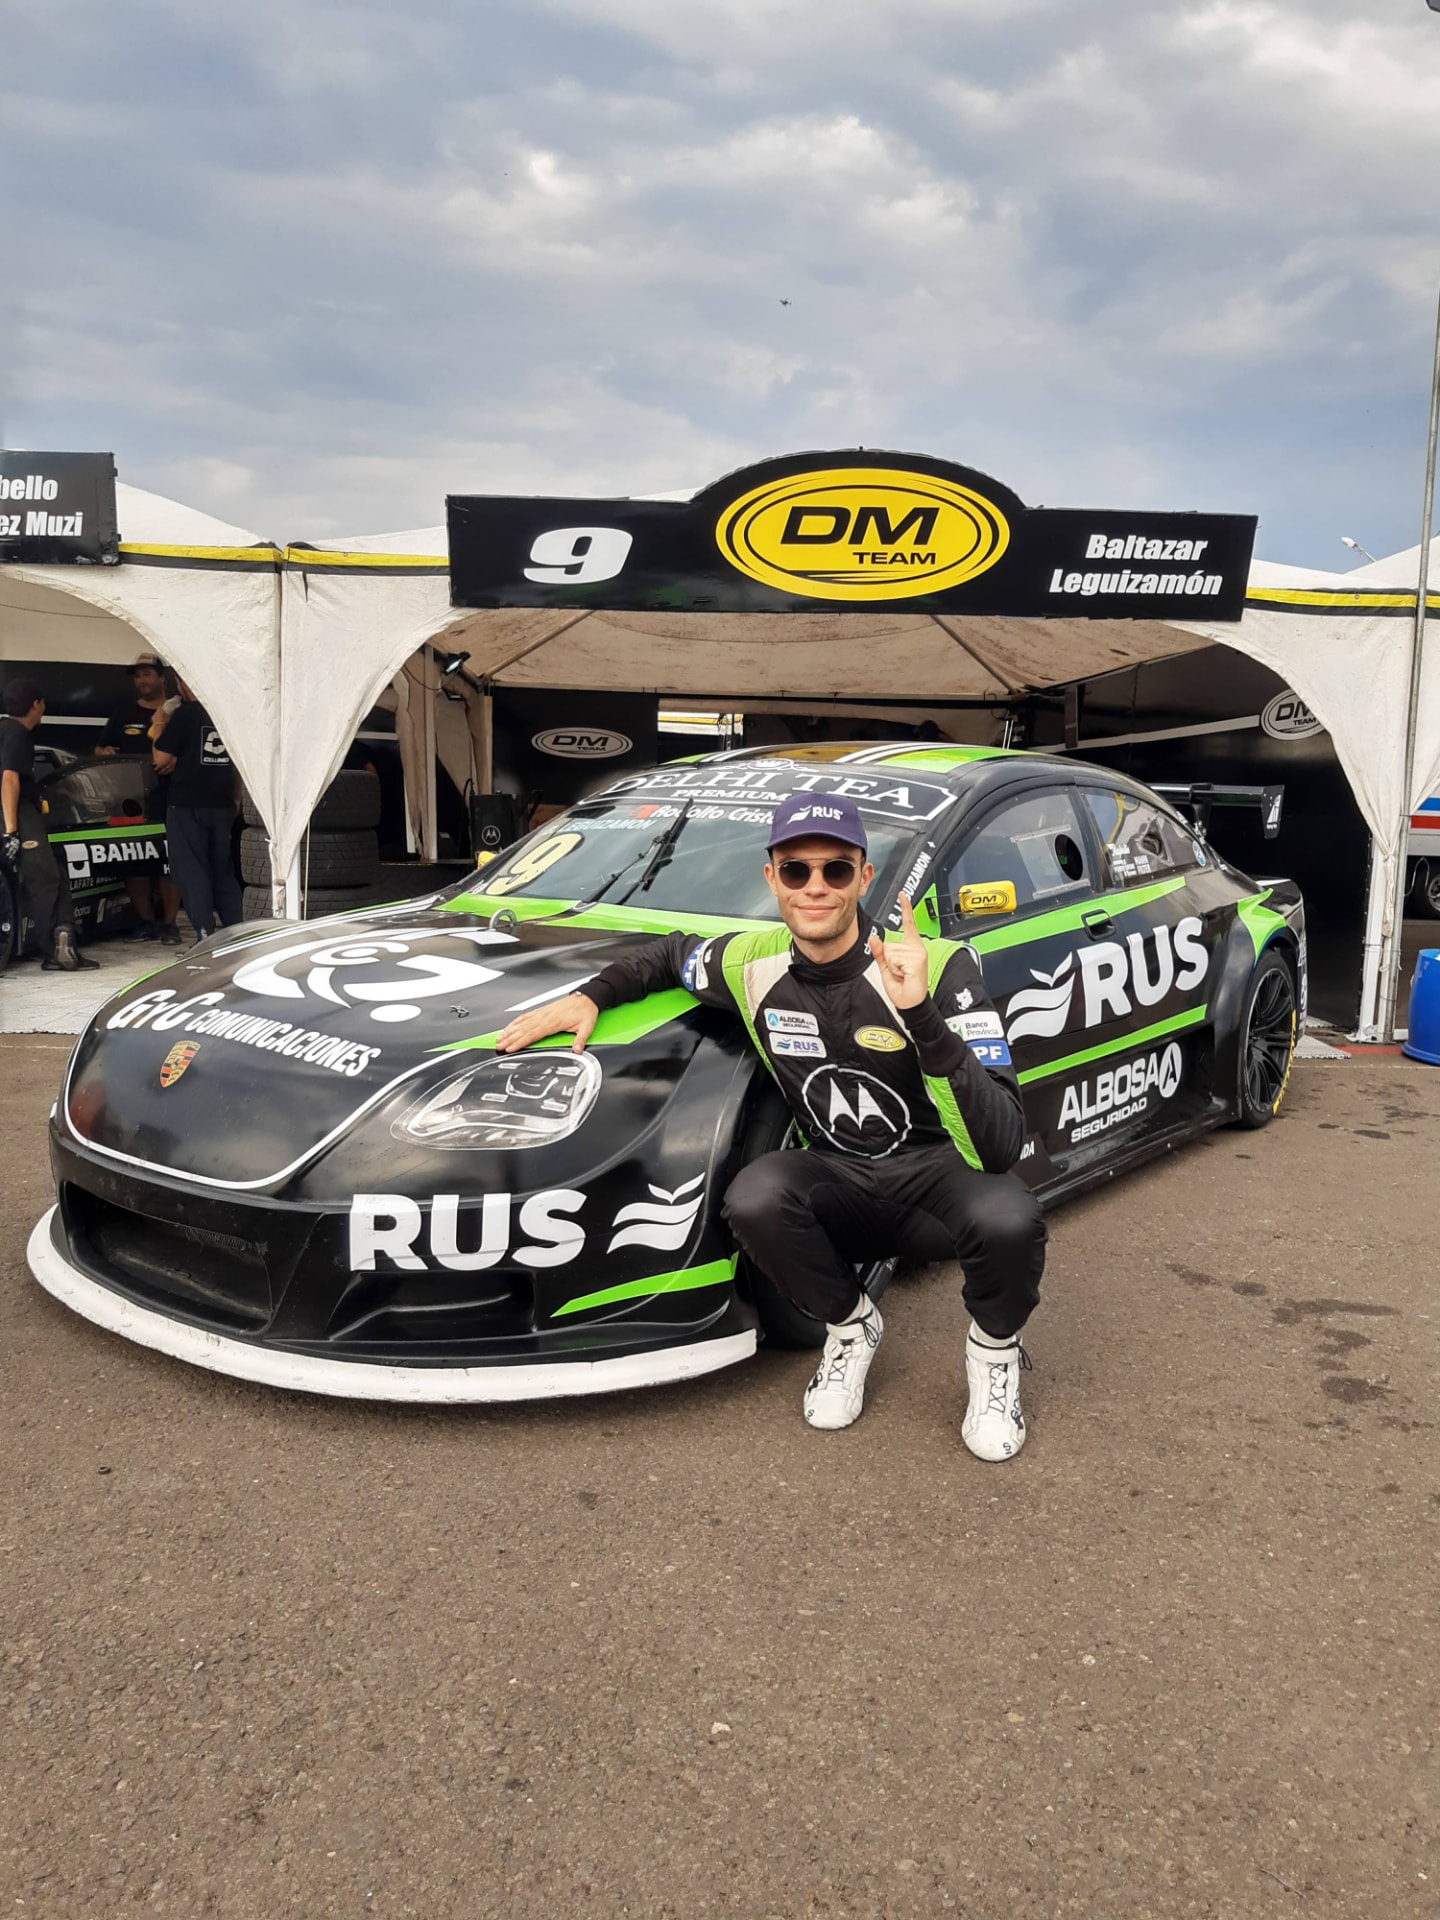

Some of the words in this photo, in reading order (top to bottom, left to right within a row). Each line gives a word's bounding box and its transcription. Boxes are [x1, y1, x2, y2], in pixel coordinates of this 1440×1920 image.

[0, 475, 58, 500] bello
[25, 511, 83, 536] Muzi
[780, 506, 940, 546] DM
[523, 527, 633, 584] 9
[852, 551, 937, 565] TEAM
[1085, 534, 1209, 561] Baltazar
[1049, 568, 1223, 596] Leguizamón
[552, 735, 609, 747] DM
[600, 771, 783, 796] DELHI
[792, 773, 914, 809] TEA
[670, 789, 792, 801] PREMIUM
[812, 808, 843, 821] RUS
[90, 842, 159, 863] BAHIA
[485, 832, 582, 895] 9
[970, 895, 997, 904] DM
[1077, 916, 1209, 1029] RUS
[184, 1008, 382, 1077] COMUNICACIONES
[792, 1040, 820, 1052] RUS
[1057, 1052, 1159, 1130] ALBOSA
[1070, 1096, 1147, 1143] SEGURIDAD
[350, 1189, 587, 1272] RUS
